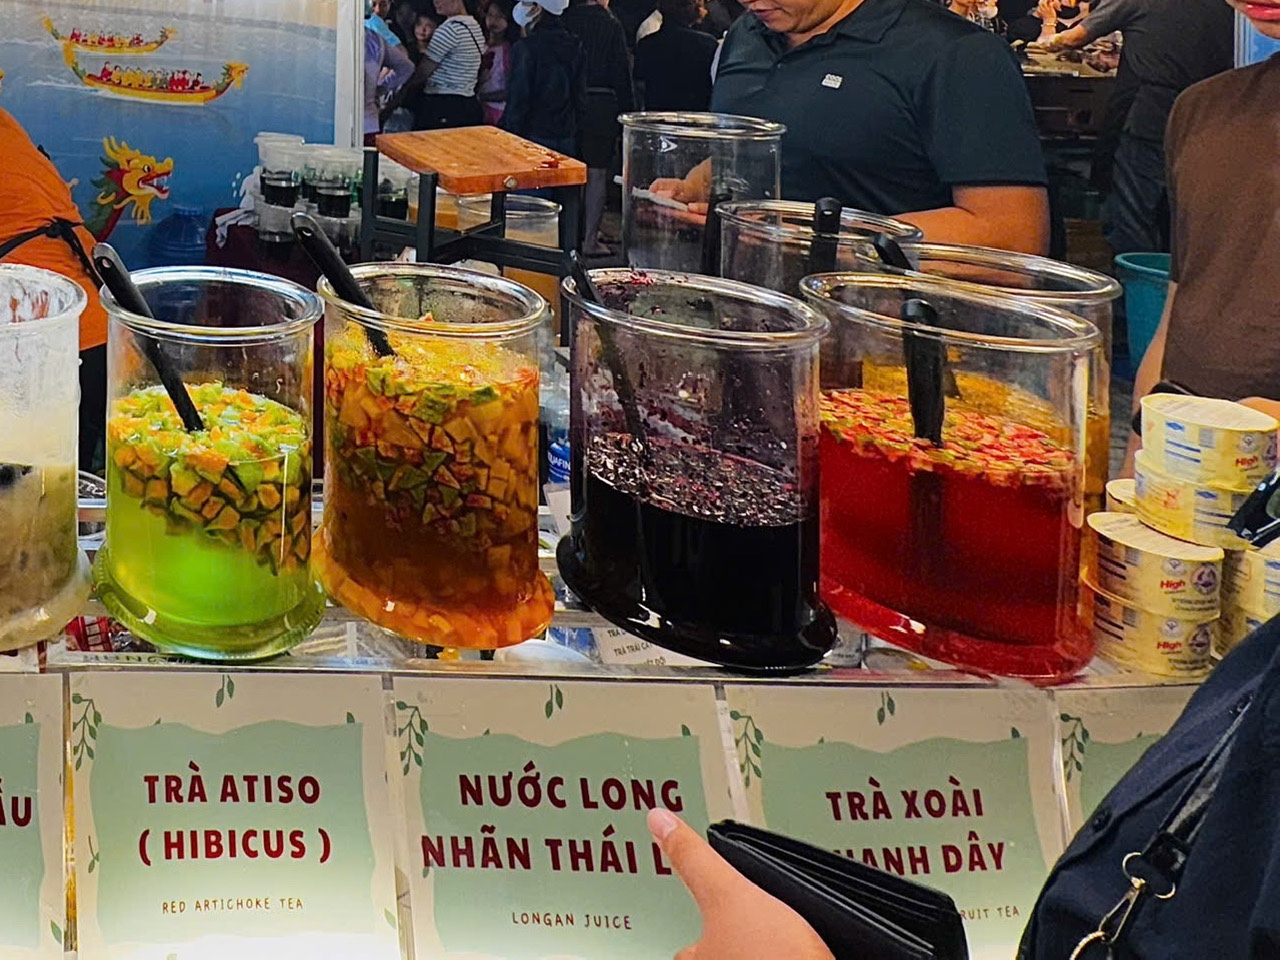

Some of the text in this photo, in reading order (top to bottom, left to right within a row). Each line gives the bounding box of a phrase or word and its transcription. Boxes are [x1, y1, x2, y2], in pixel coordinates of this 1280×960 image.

[144, 760, 321, 805] TRÀ ATISO
[458, 760, 684, 813] NƯỚC LONG
[825, 775, 984, 821] TRÀ XOÀI
[420, 824, 532, 870] NHÃN
[544, 823, 638, 875] THÁI
[943, 831, 1005, 874] DÂY
[162, 897, 303, 914] RED ARTICHOKE TEA
[512, 911, 632, 930] LONGAN JUICE
[960, 905, 1020, 920] RUIT TEA
